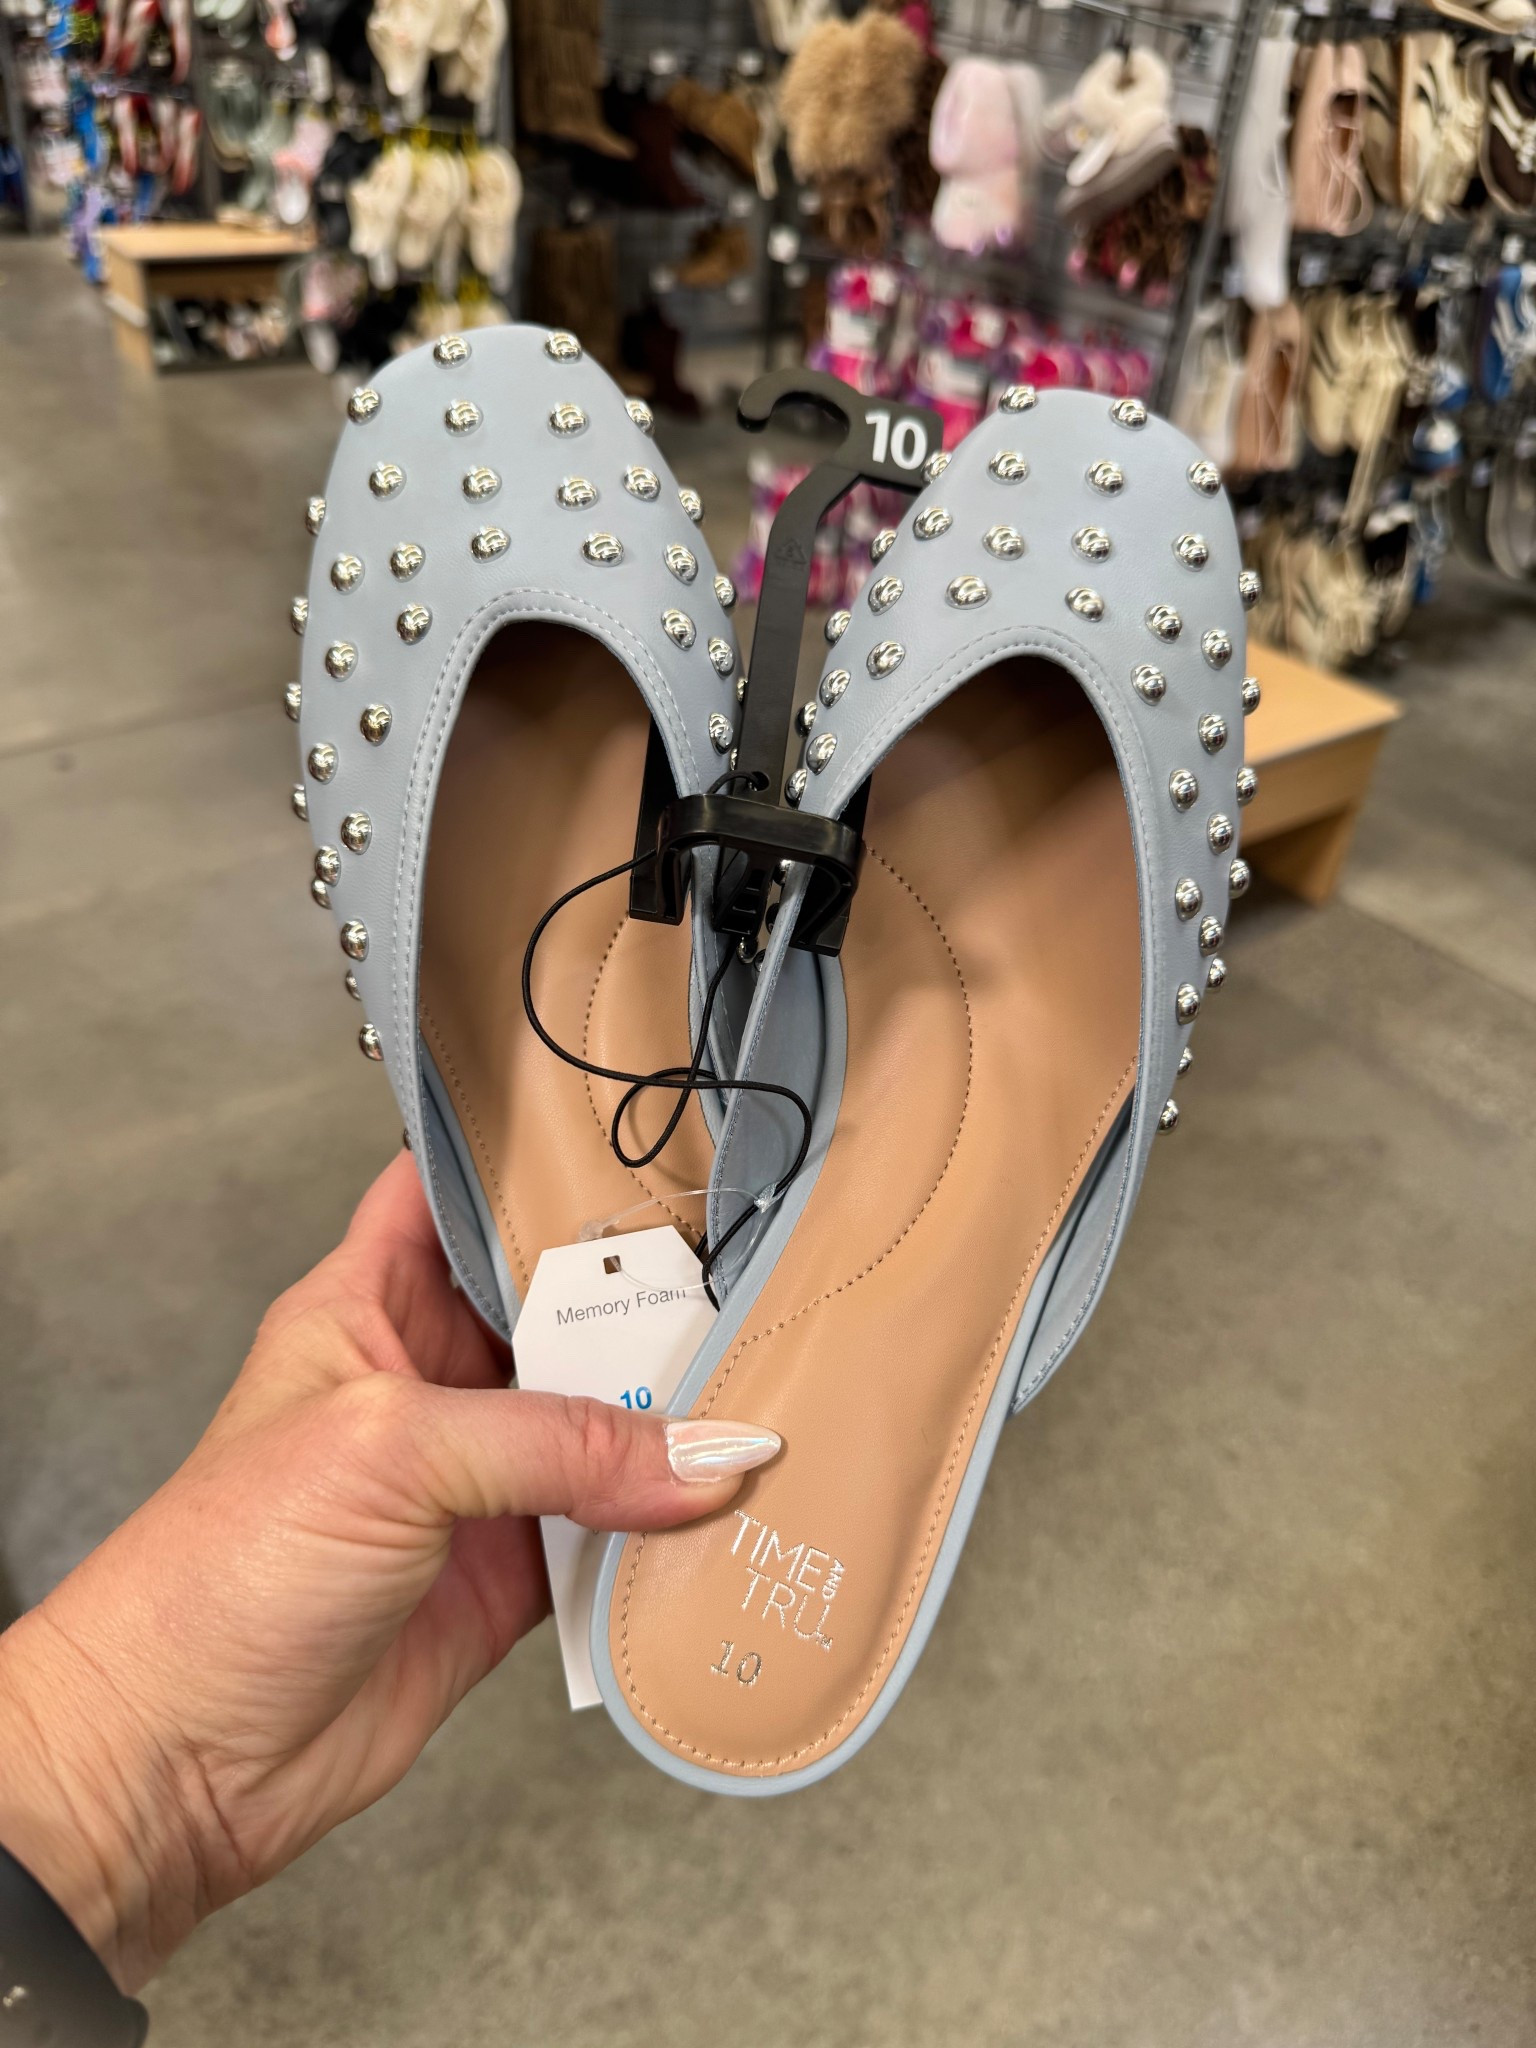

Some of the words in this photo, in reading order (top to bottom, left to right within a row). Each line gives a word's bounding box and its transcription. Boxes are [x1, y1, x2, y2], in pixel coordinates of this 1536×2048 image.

[865, 411, 928, 470] 10
[556, 1298, 631, 1325] Memory
[620, 1386, 652, 1410] 10
[731, 1510, 830, 1593] TIME
[741, 1566, 830, 1639] TRU
[710, 1639, 762, 1687] 10
